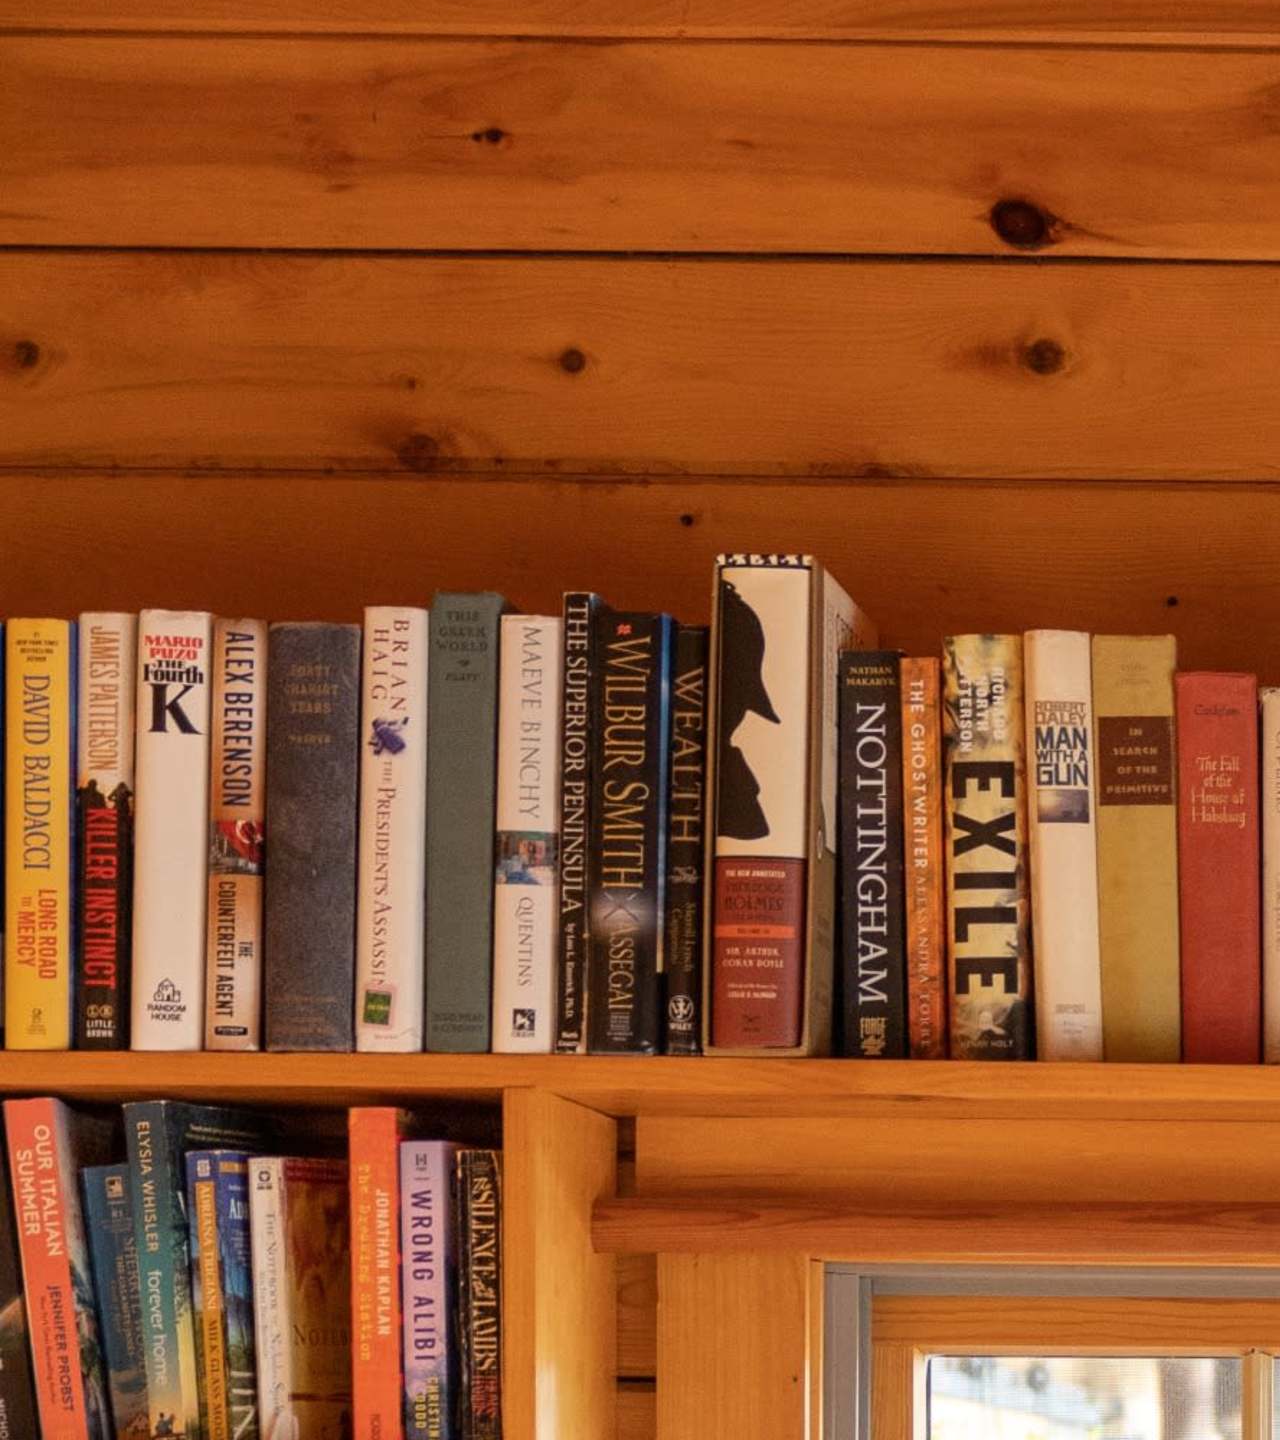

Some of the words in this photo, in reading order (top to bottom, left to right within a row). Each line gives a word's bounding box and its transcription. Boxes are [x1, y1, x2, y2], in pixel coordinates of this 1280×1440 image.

[144, 635, 203, 650] MARIO
[149, 648, 199, 660] PUZO
[224, 631, 255, 684] ALEX
[566, 603, 589, 649] THE
[143, 665, 204, 685] Fourth
[520, 626, 541, 709] MAEVE
[602, 635, 652, 769] WILBUR
[911, 679, 923, 713] THE
[22, 674, 52, 746] DAVID
[149, 684, 204, 735] K
[566, 656, 587, 772] SUPERIOR
[1036, 728, 1087, 750] MAN
[221, 690, 253, 808] BERENSON
[520, 719, 542, 818] BINCHY
[1037, 764, 1088, 786] GUN
[22, 754, 52, 870] BALDACCI
[911, 724, 929, 869] GHOSTWRITER
[83, 807, 116, 881] KILLER
[561, 784, 586, 913] PENINSULA
[603, 781, 649, 891] SMITH
[855, 703, 888, 1004] NOTTINGHAM
[951, 762, 1018, 995] EXILE
[83, 887, 116, 989] INSTINCT
[375, 1189, 391, 1265] JONATHAN
[410, 1190, 435, 1281] WRONG
[377, 1271, 391, 1337] KAPLAN
[412, 1297, 436, 1361] ALIBI
